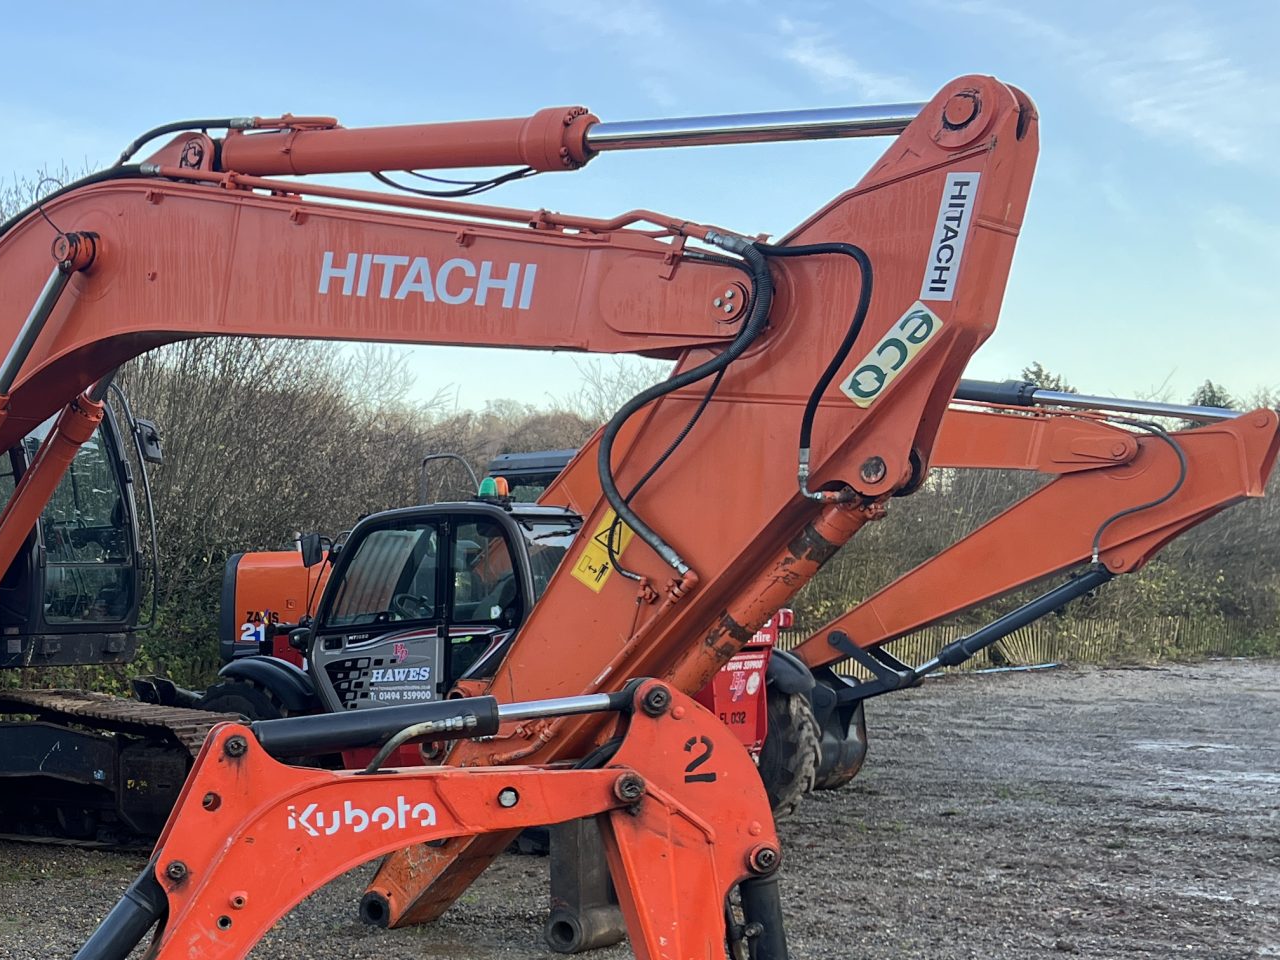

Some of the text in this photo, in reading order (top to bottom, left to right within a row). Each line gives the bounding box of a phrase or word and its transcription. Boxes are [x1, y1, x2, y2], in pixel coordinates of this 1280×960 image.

[928, 180, 970, 292] HITACHI
[318, 251, 537, 310] HITACHI
[246, 609, 280, 624] ZAXIS
[370, 666, 431, 682] HAWES
[379, 691, 401, 700] 01494
[403, 690, 431, 700] 559900
[731, 711, 746, 724] 032
[683, 735, 717, 784] 2
[287, 796, 437, 837] Kubota
